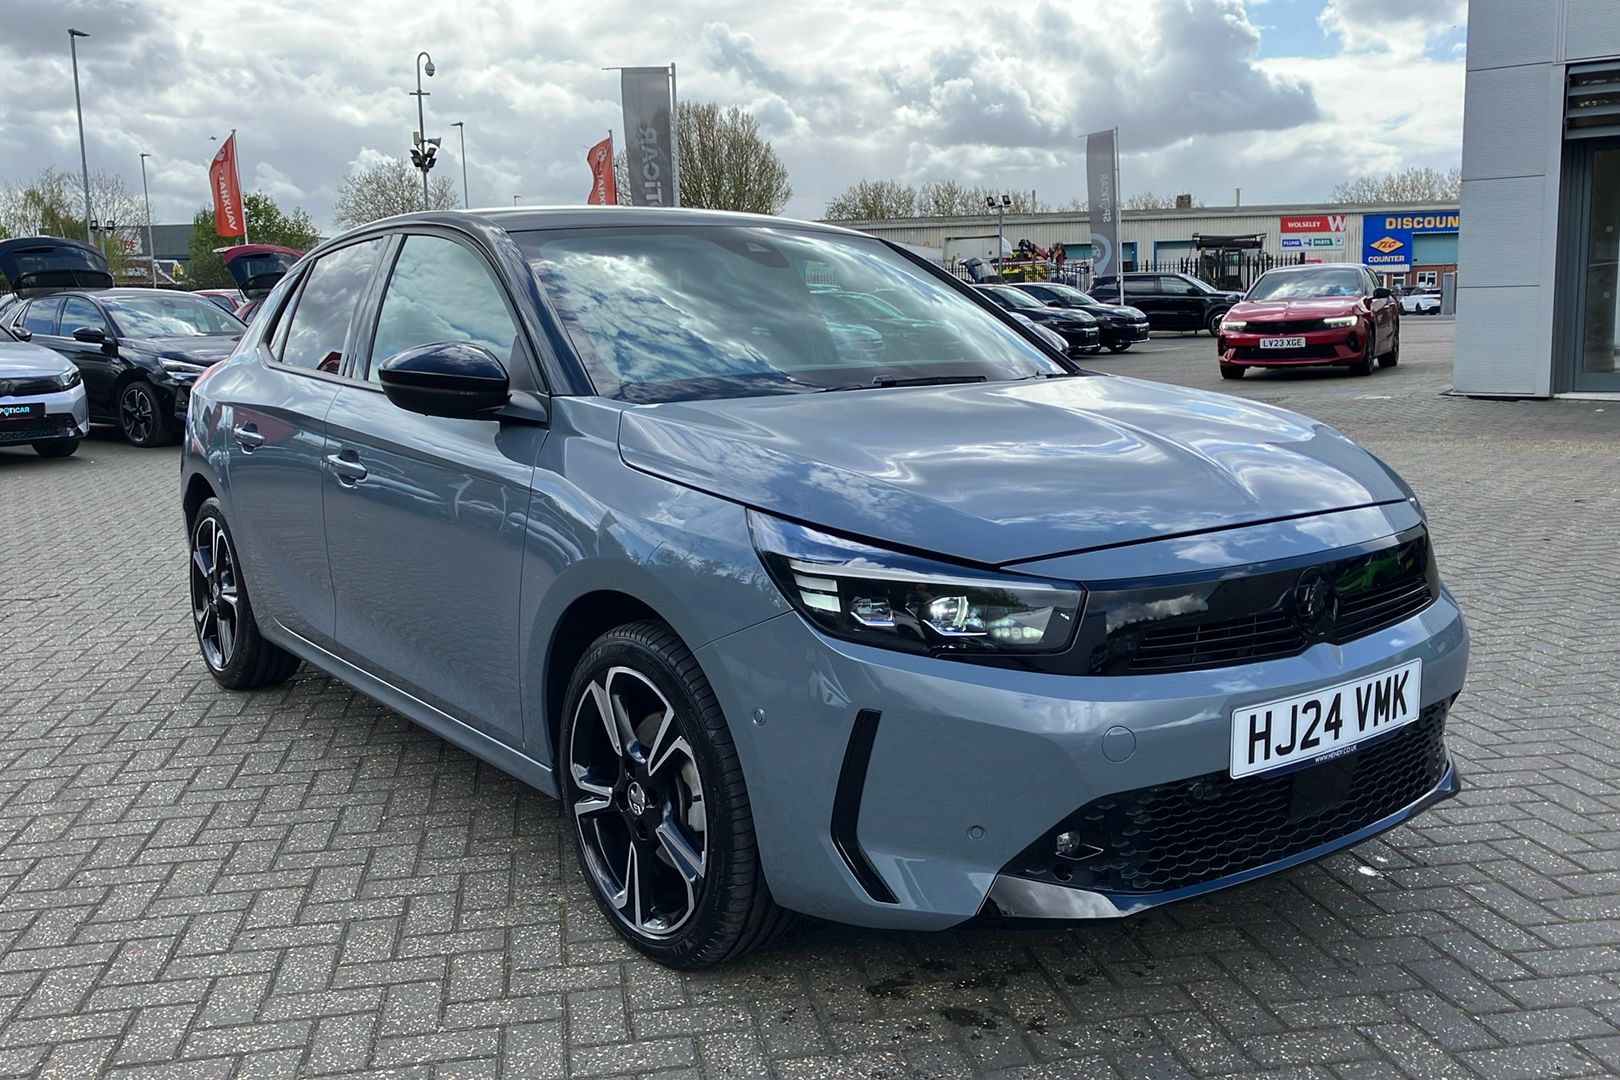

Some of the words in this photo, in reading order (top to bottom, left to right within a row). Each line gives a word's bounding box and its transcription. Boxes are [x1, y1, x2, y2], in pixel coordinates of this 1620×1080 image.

[1385, 216, 1459, 230] DISCOUN
[1368, 255, 1405, 263] COUNTER
[1263, 339, 1285, 347] LV23
[1286, 338, 1302, 346] XGE
[1248, 692, 1343, 765] HJ24
[1355, 670, 1409, 732] VMK
